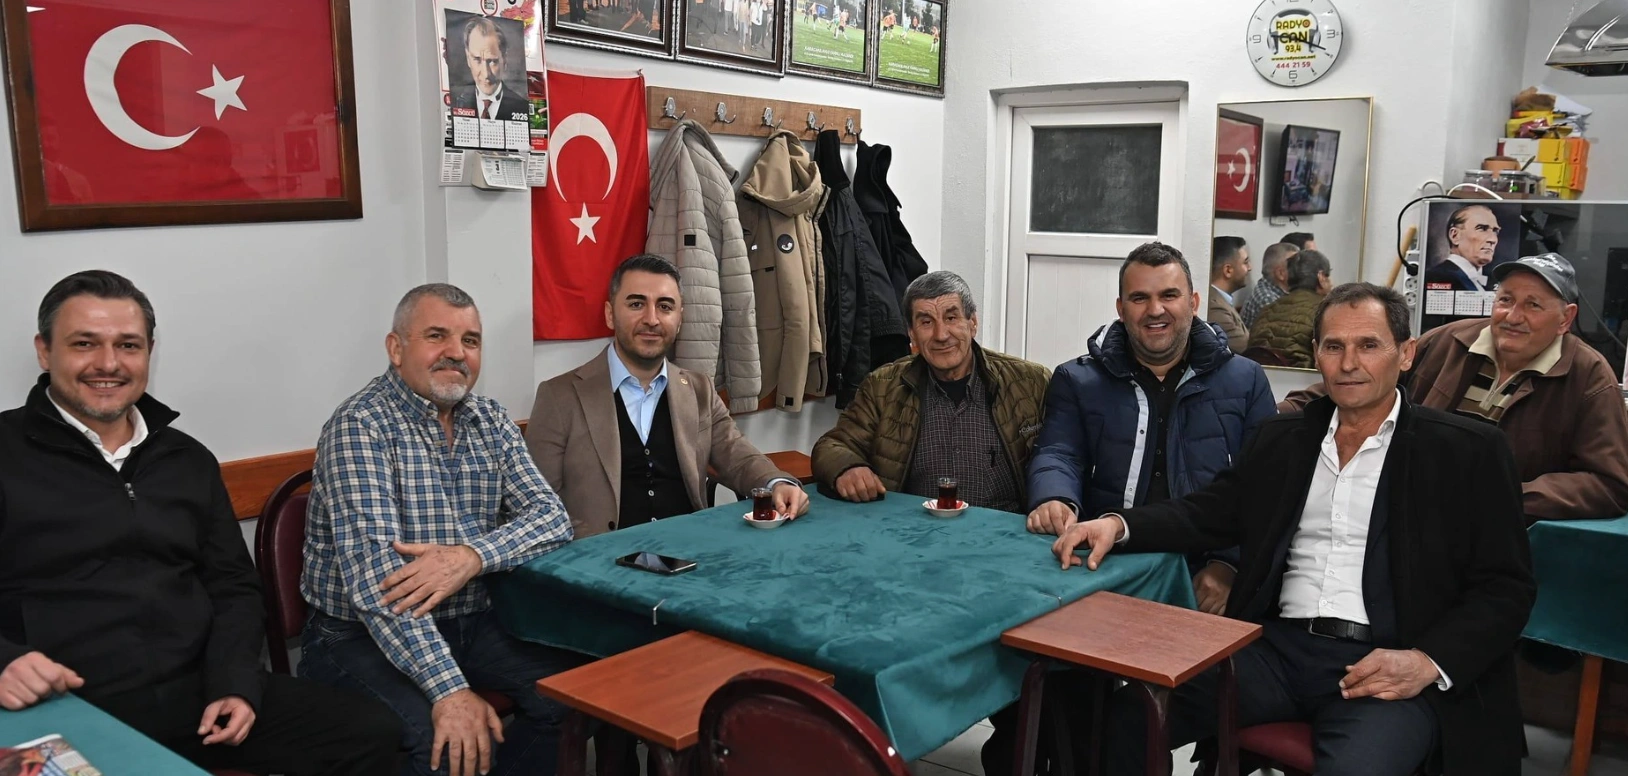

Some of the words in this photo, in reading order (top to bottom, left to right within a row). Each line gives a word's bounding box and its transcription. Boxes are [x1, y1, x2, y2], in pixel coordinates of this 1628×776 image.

[1276, 19, 1311, 30] RADYO
[1252, 34, 1262, 44] 9
[1279, 31, 1308, 44] CAN
[1326, 29, 1336, 39] 3
[1285, 45, 1302, 53] 93,4
[1288, 70, 1298, 80] 6
[512, 112, 528, 121] 2026
